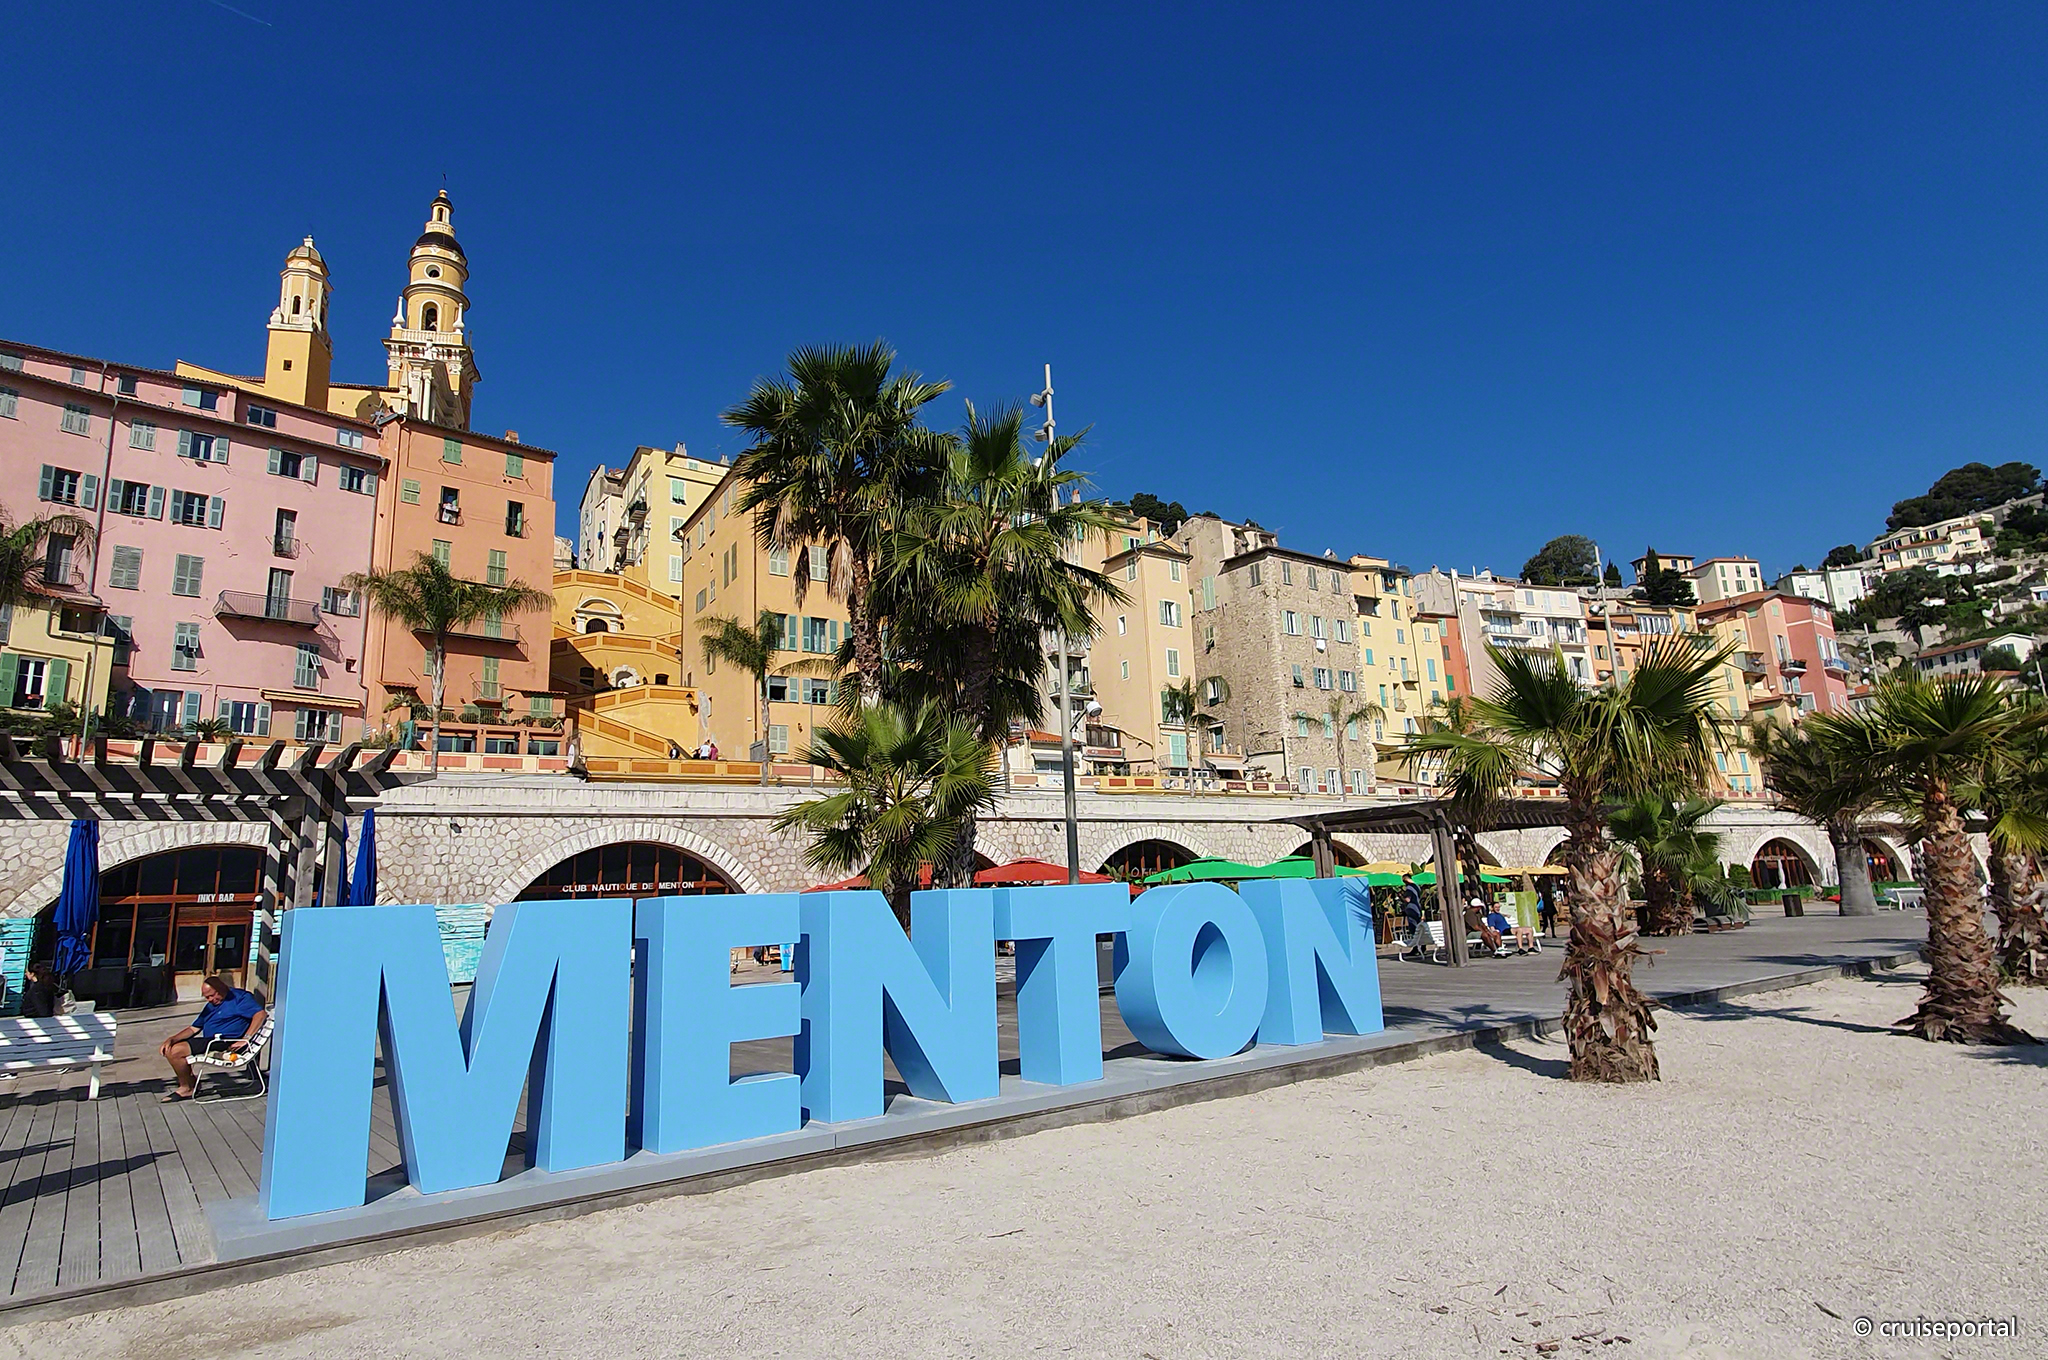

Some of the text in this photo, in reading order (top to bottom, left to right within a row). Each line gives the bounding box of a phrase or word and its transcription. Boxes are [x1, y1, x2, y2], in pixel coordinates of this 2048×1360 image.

[562, 881, 695, 893] CLUB NAUTIQUE DE MENTON
[197, 893, 235, 903] INKY BAR
[258, 875, 1385, 1222] MENTON
